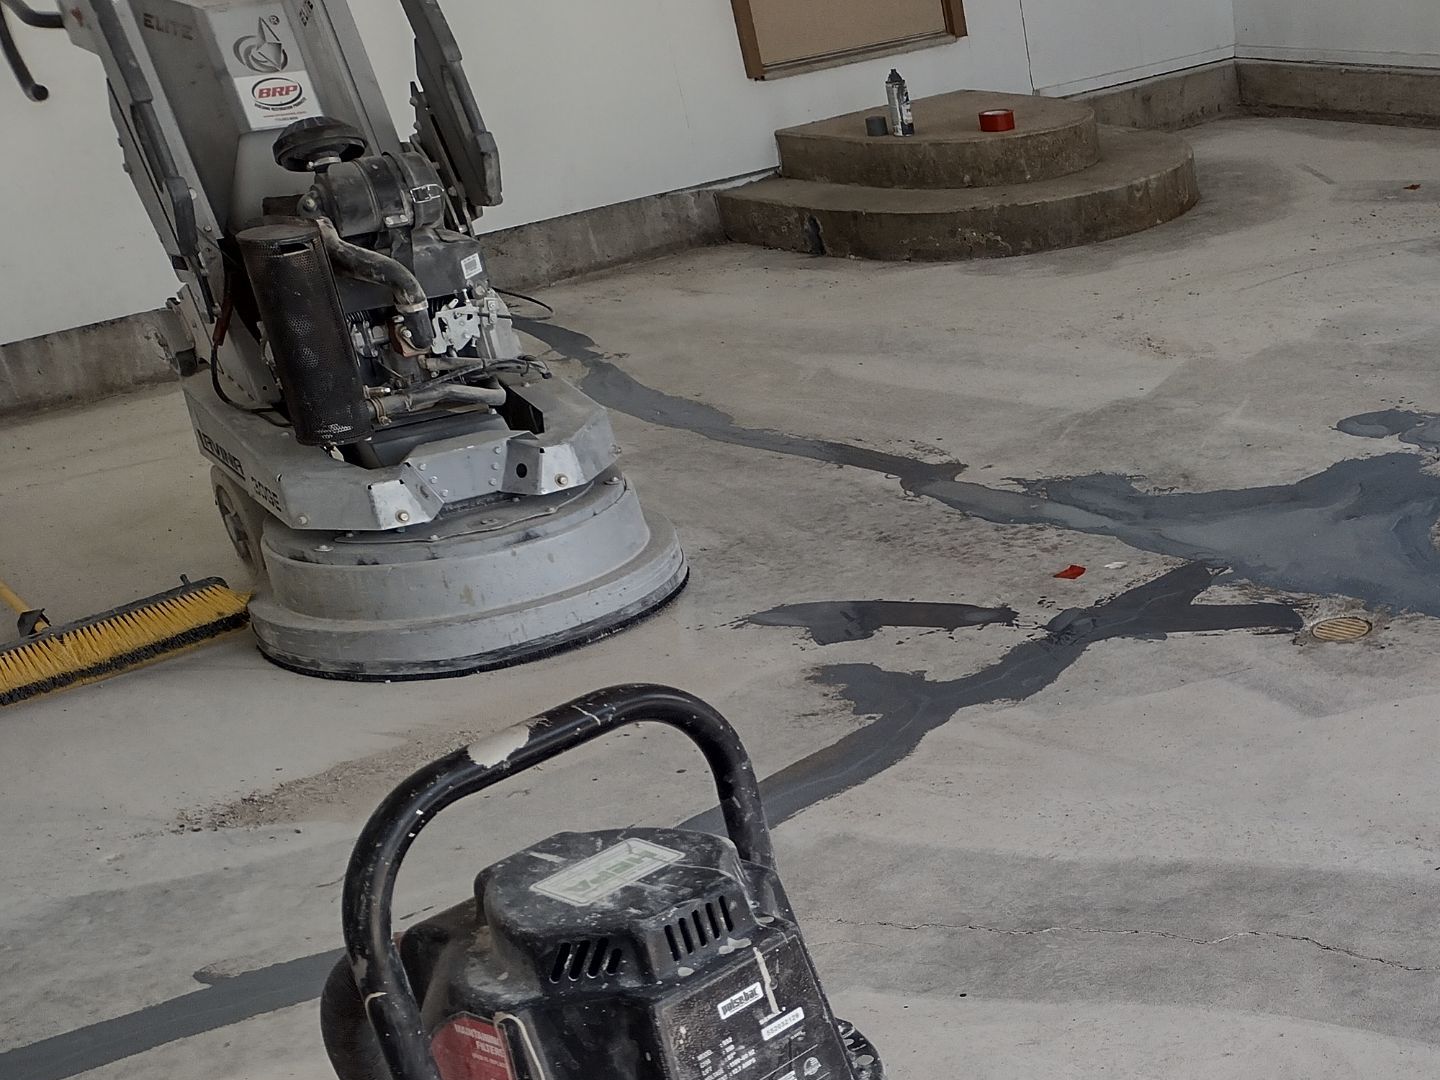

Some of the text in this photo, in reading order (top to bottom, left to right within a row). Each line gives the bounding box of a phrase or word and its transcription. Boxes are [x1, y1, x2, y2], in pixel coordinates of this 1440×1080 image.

[143, 13, 193, 40] ELITE
[258, 85, 298, 98] BRP
[562, 851, 657, 893] HEPA
